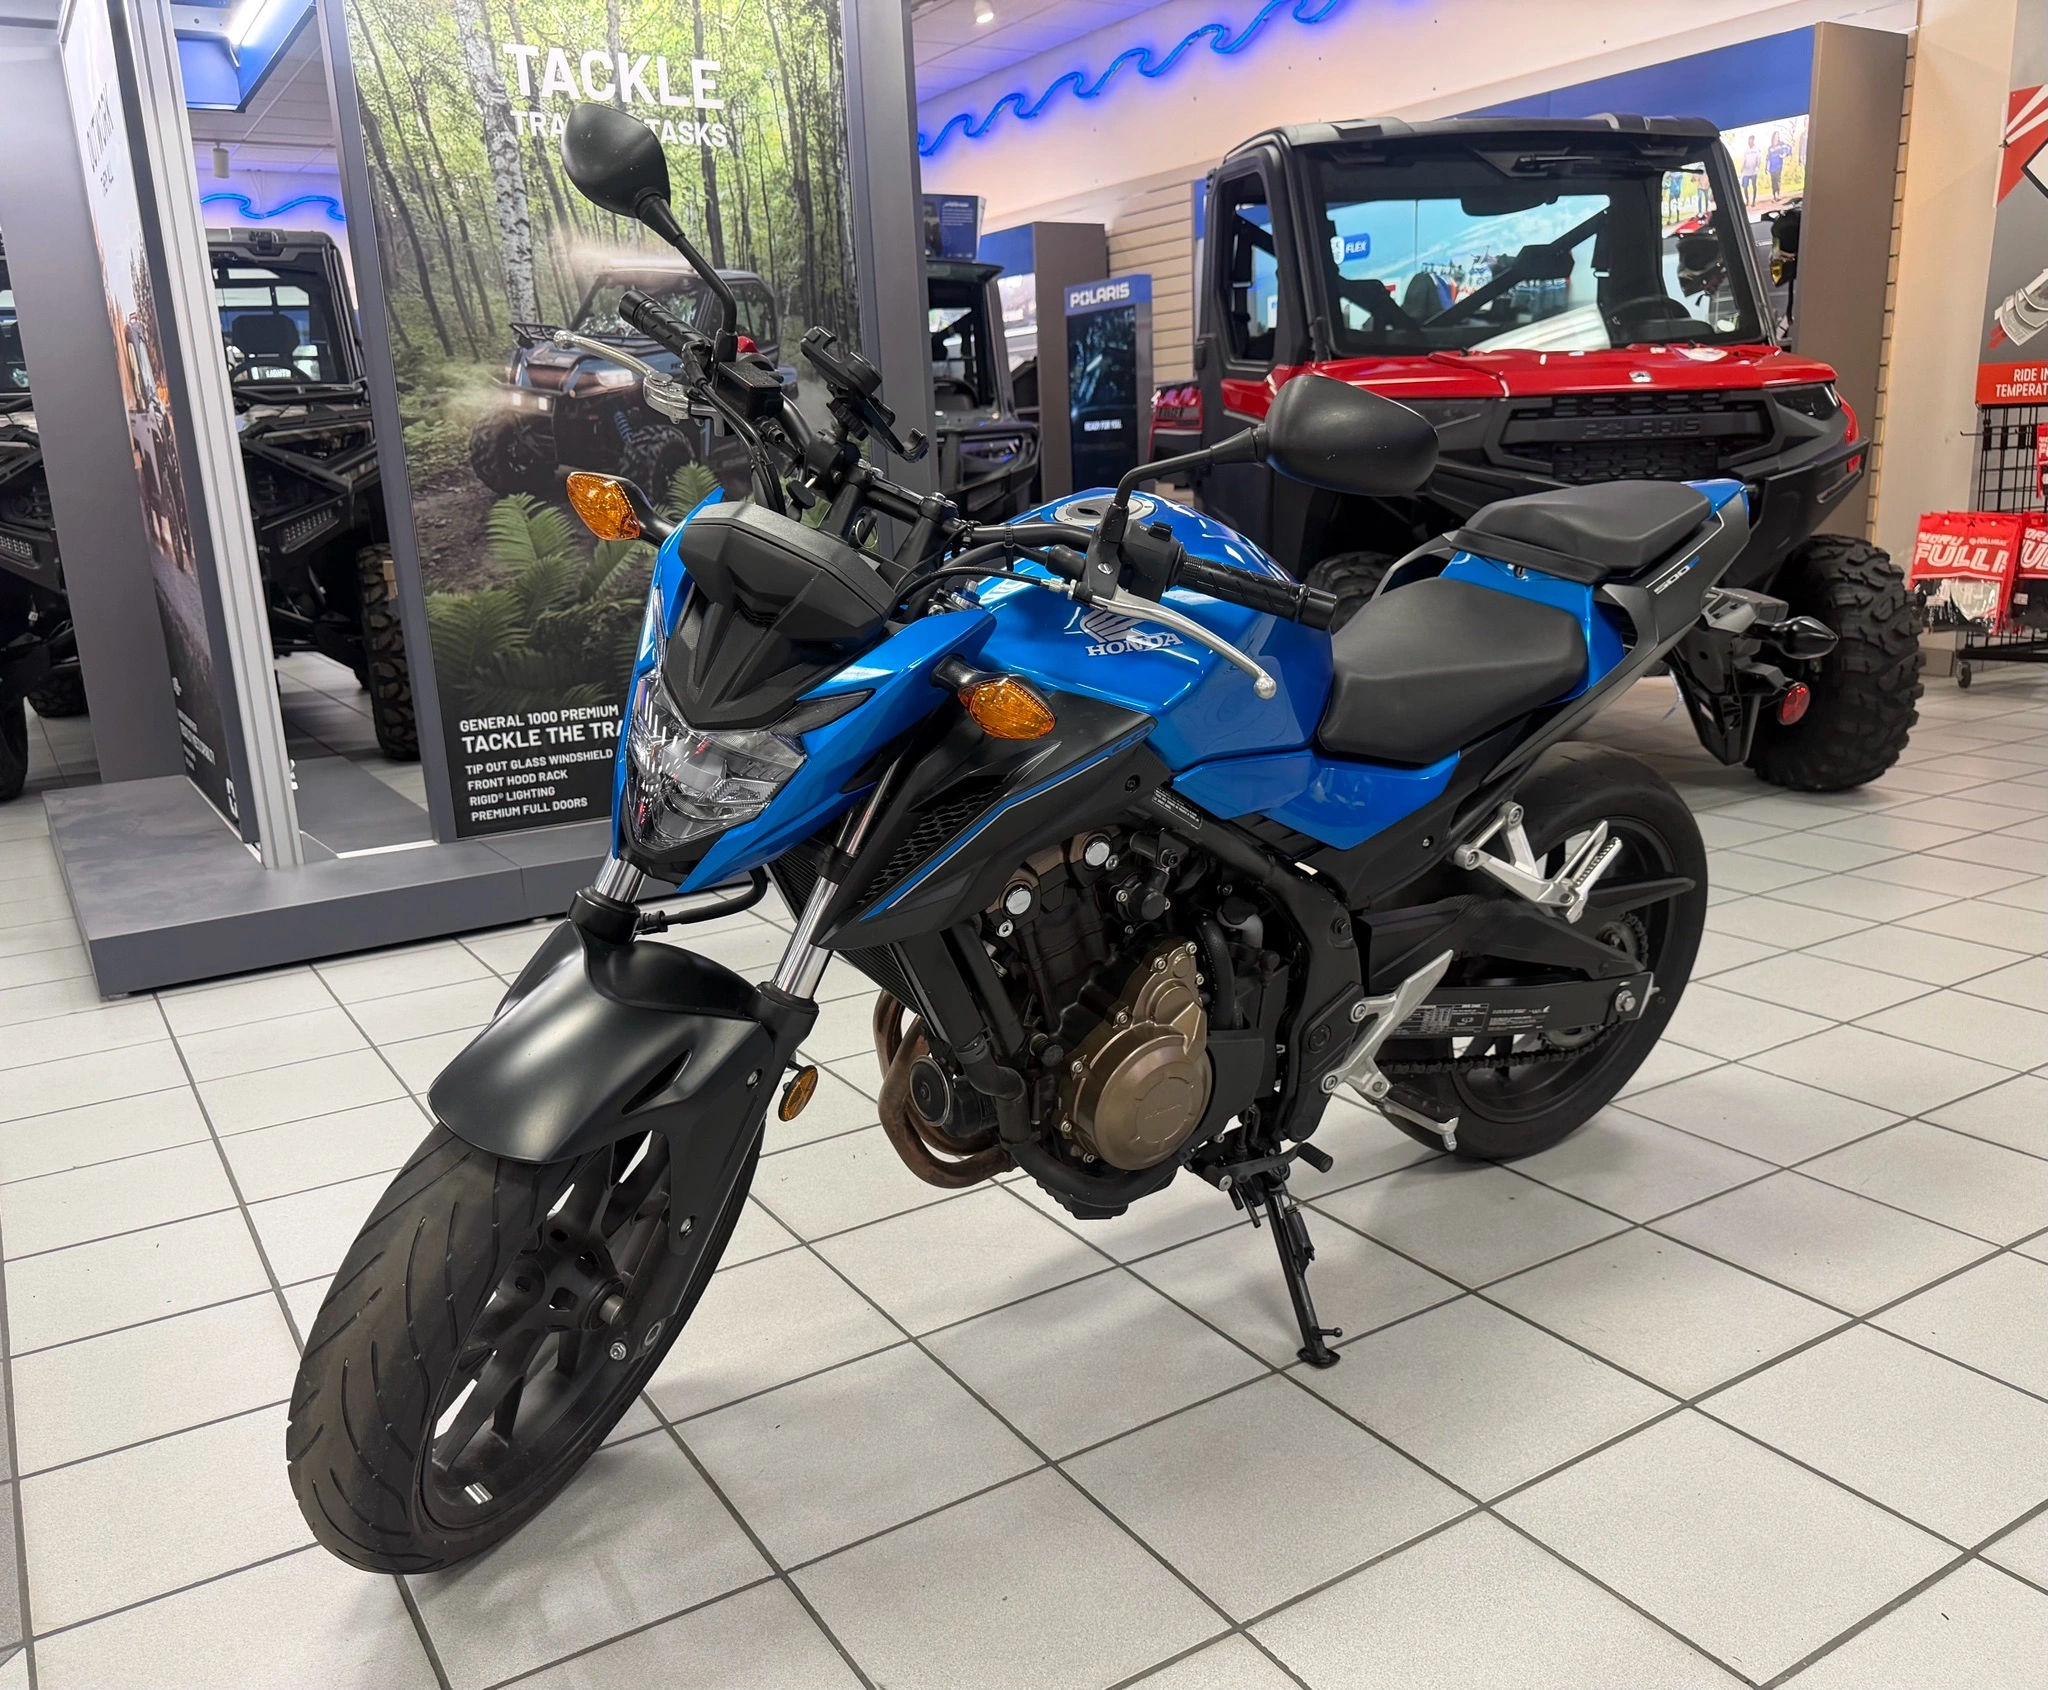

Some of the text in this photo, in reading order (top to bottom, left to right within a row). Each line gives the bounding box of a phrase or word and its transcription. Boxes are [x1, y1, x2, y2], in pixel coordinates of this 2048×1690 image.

[502, 43, 724, 109] TACKLE
[510, 109, 728, 148] TRA TASKS
[1345, 240, 1367, 254] FLEX
[1070, 282, 1130, 308] POLARIS
[2013, 367, 2038, 382] RIDE
[1914, 542, 1990, 572] FULL
[1085, 632, 1184, 656] HONDA
[459, 704, 619, 733] GENERAL 1000 PREMIUM
[461, 729, 542, 754] TACKLE
[545, 724, 586, 744] THE
[465, 748, 614, 775] TIP OUT GLASS WINDSHIELD
[467, 769, 569, 791] FRONT HOOD RACK
[506, 785, 556, 802] LIGHTING
[471, 797, 589, 822] PREMIUM FULL DOORS
